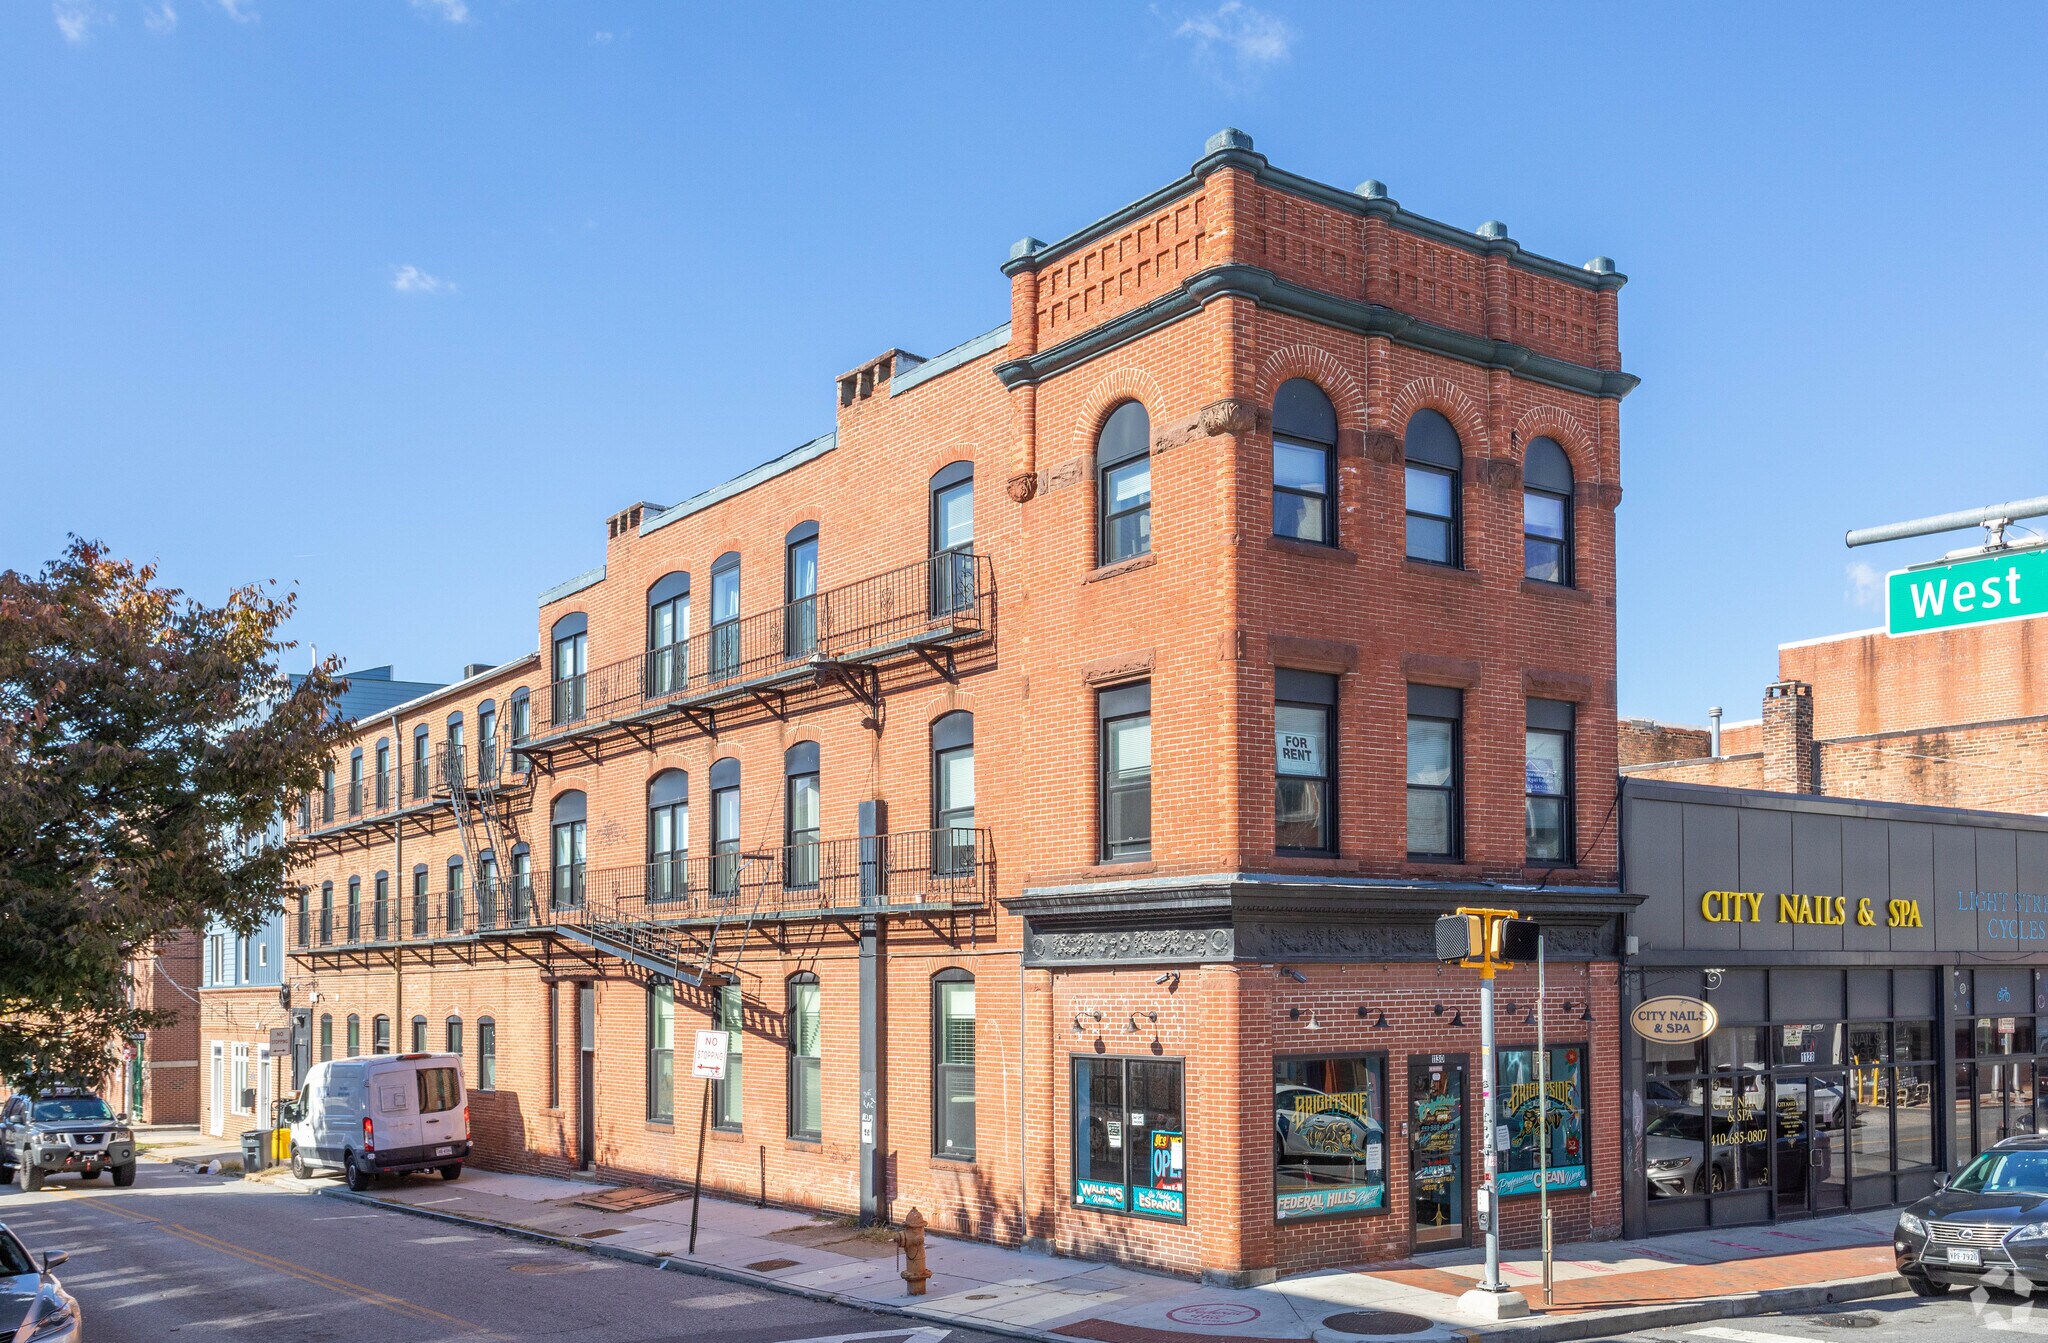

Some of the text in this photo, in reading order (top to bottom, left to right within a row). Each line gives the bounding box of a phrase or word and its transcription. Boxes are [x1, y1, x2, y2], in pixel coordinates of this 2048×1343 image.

[1910, 566, 2021, 618] West
[1285, 736, 1307, 748] FOR
[1282, 747, 1312, 761] RENT
[1701, 890, 1924, 928] CITY NAILS & SPA
[1957, 890, 2009, 912] LIGHT
[1987, 918, 2047, 940] CYCLES
[1638, 1011, 1708, 1021] CITY NAILS
[1654, 1023, 1691, 1034] & SPA
[705, 1037, 718, 1046] NO
[697, 1050, 724, 1061] STOPPING
[1293, 1092, 1369, 1130] BRIGHTSIDE
[1727, 1108, 1753, 1122] & SPA
[1711, 1129, 1768, 1147] 410-685-0807
[1496, 1170, 1534, 1192] Professional
[1534, 1169, 1566, 1188] CEAN
[1080, 1183, 1123, 1202] WALK-INS
[1277, 1194, 1324, 1212] FEDERAL
[1327, 1190, 1357, 1208] HILLS
[1138, 1192, 1183, 1213] ESPAÑOL
